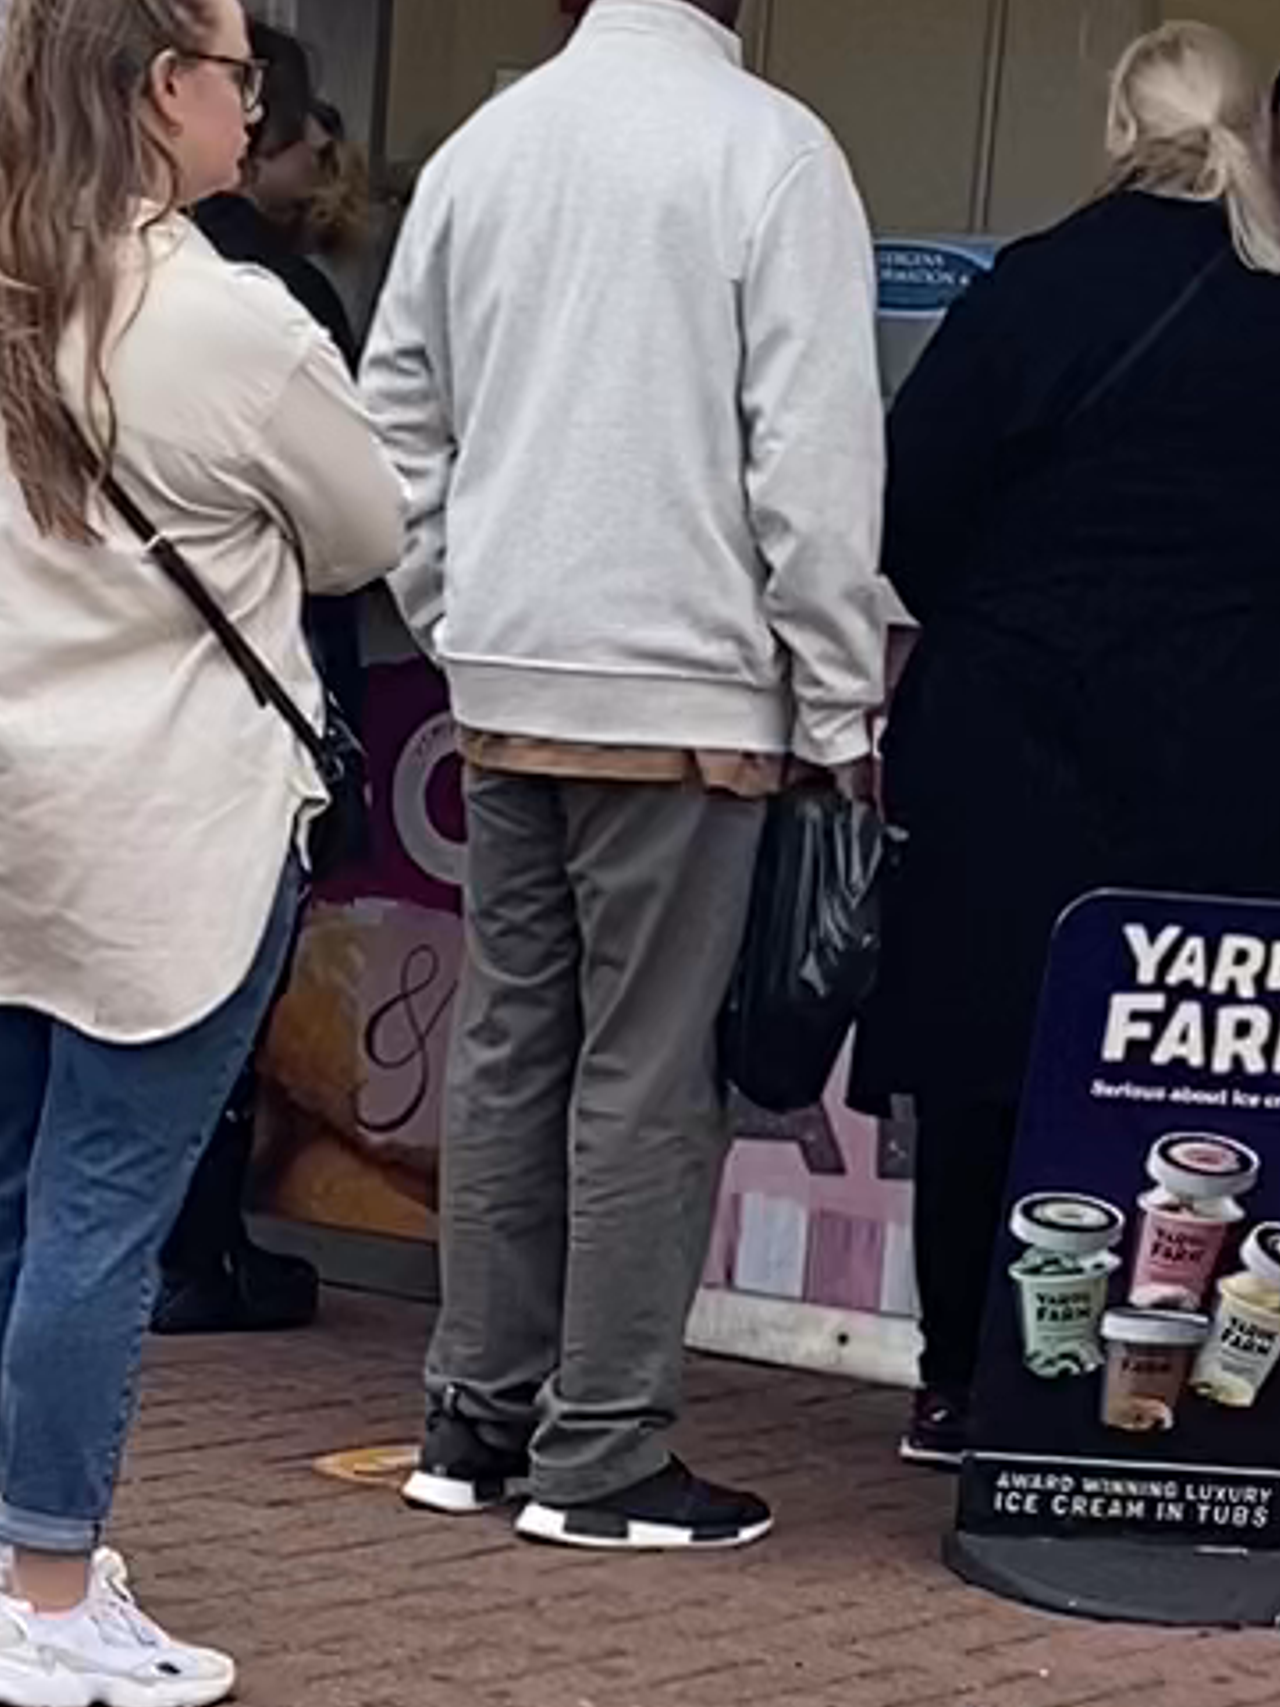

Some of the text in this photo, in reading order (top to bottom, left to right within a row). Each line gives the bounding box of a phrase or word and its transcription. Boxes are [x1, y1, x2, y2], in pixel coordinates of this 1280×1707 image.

[1169, 1085, 1228, 1105] about
[995, 1470, 1273, 1504] AWARD WINNING LUXURY
[993, 1491, 1271, 1528] ICE CREAM IN TUBS
